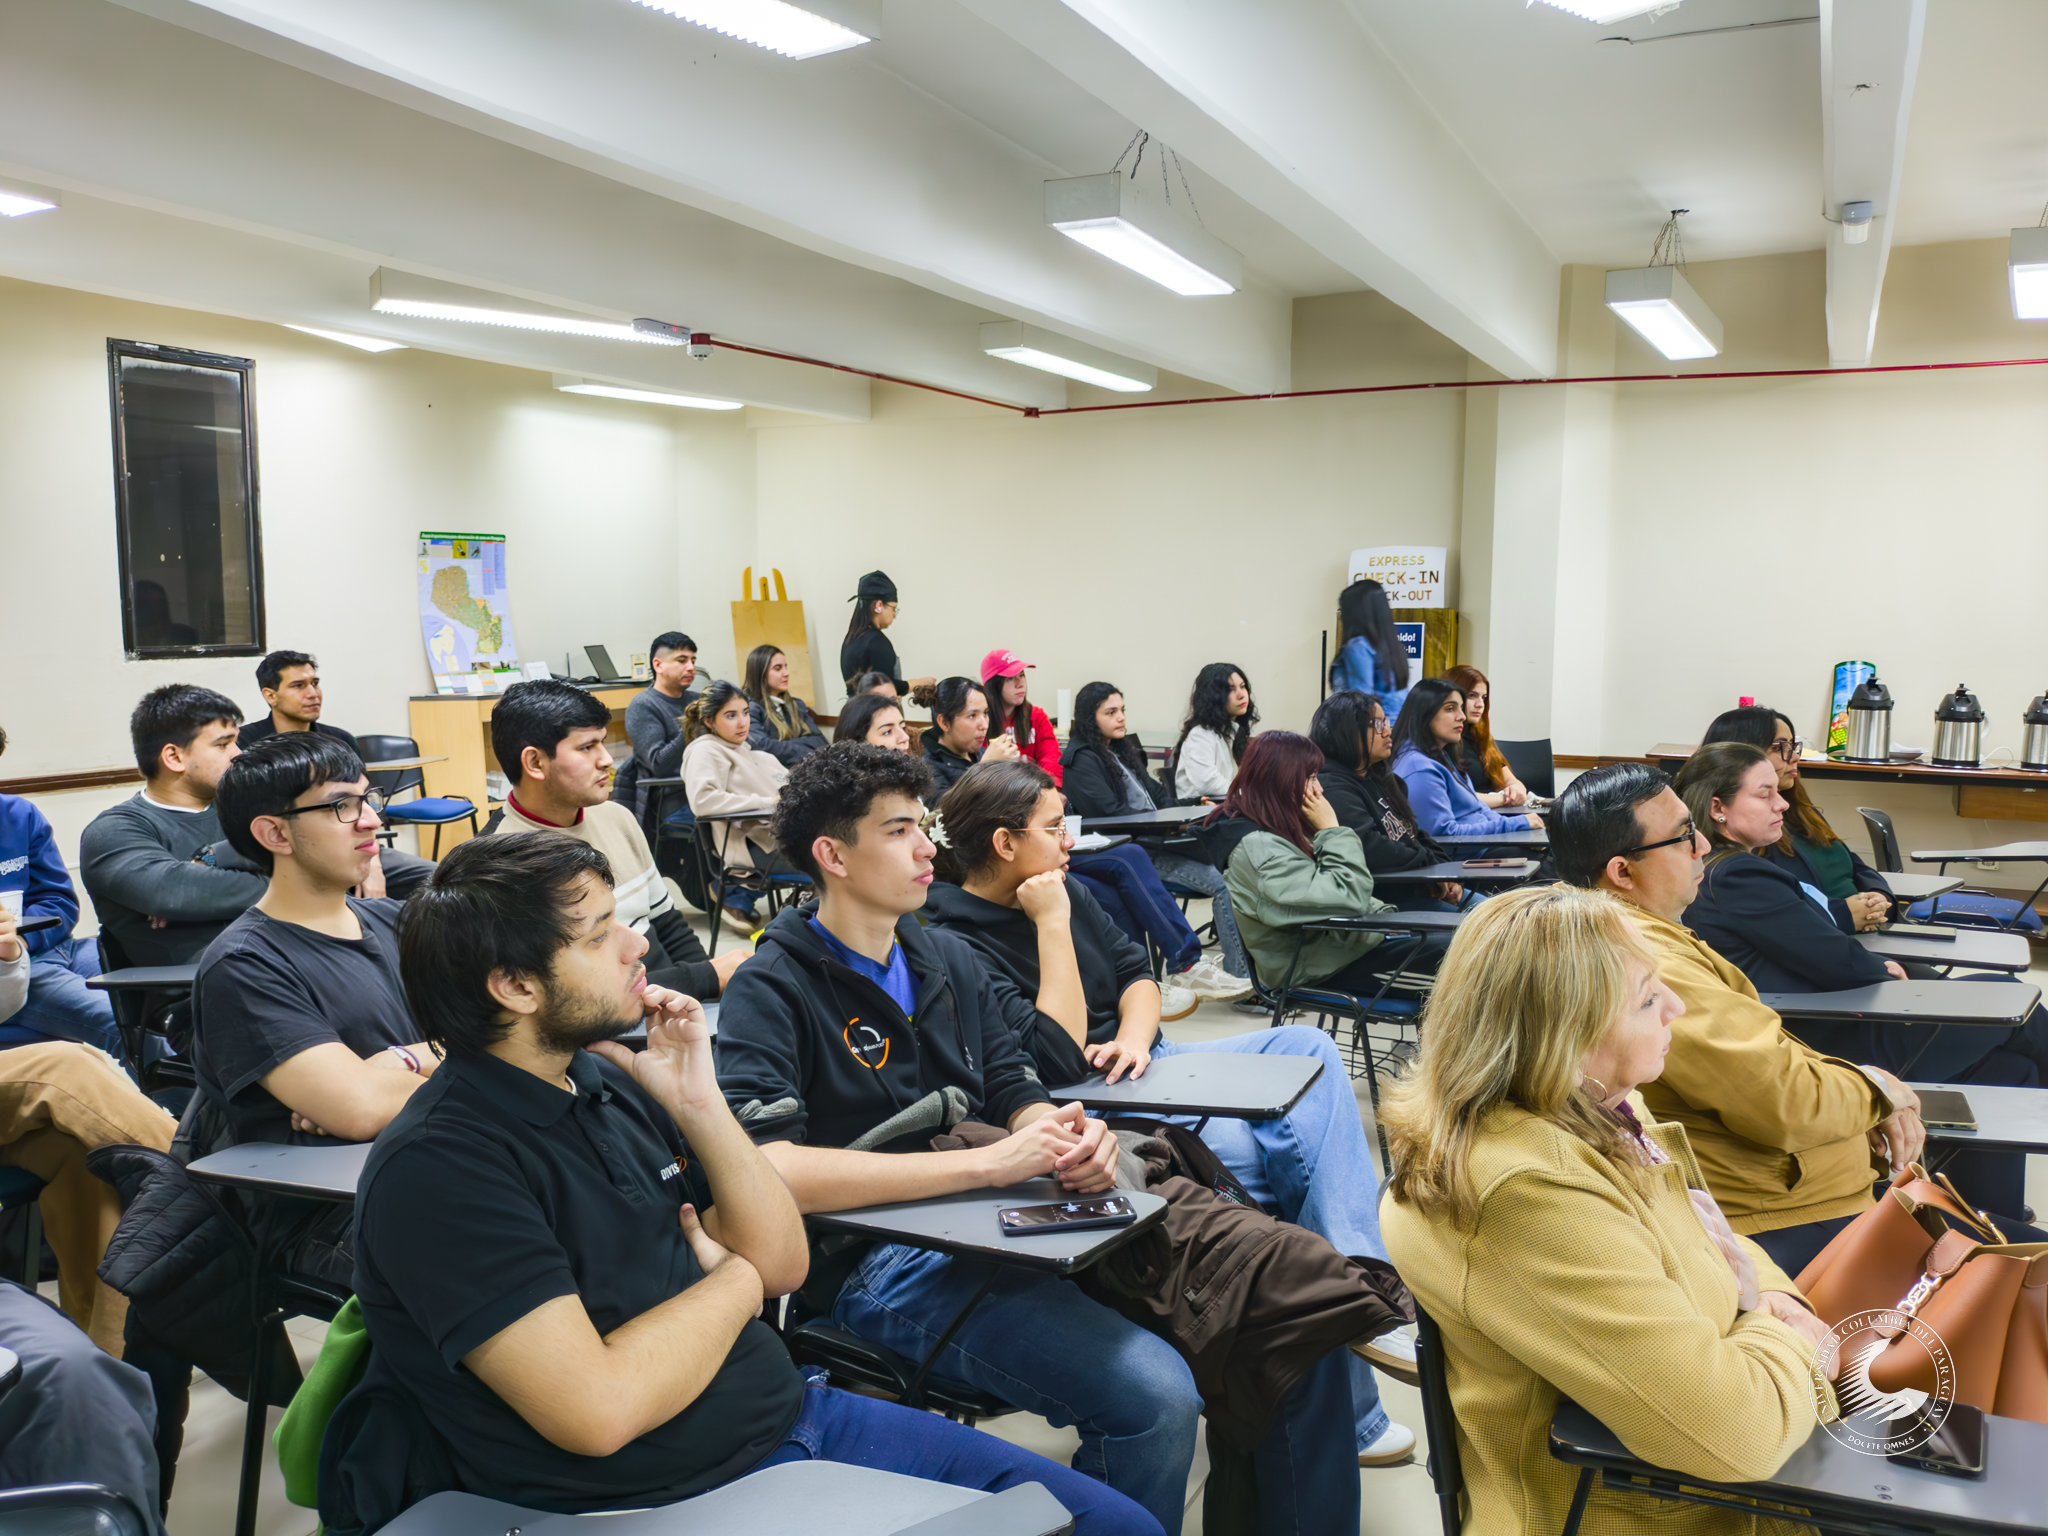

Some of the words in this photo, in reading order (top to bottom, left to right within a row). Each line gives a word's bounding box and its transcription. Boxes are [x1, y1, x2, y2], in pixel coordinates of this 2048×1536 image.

[1369, 555, 1425, 567] EXPRESS
[1353, 570, 1439, 584] CHECK-IN
[1385, 590, 1432, 601] CK-OUT
